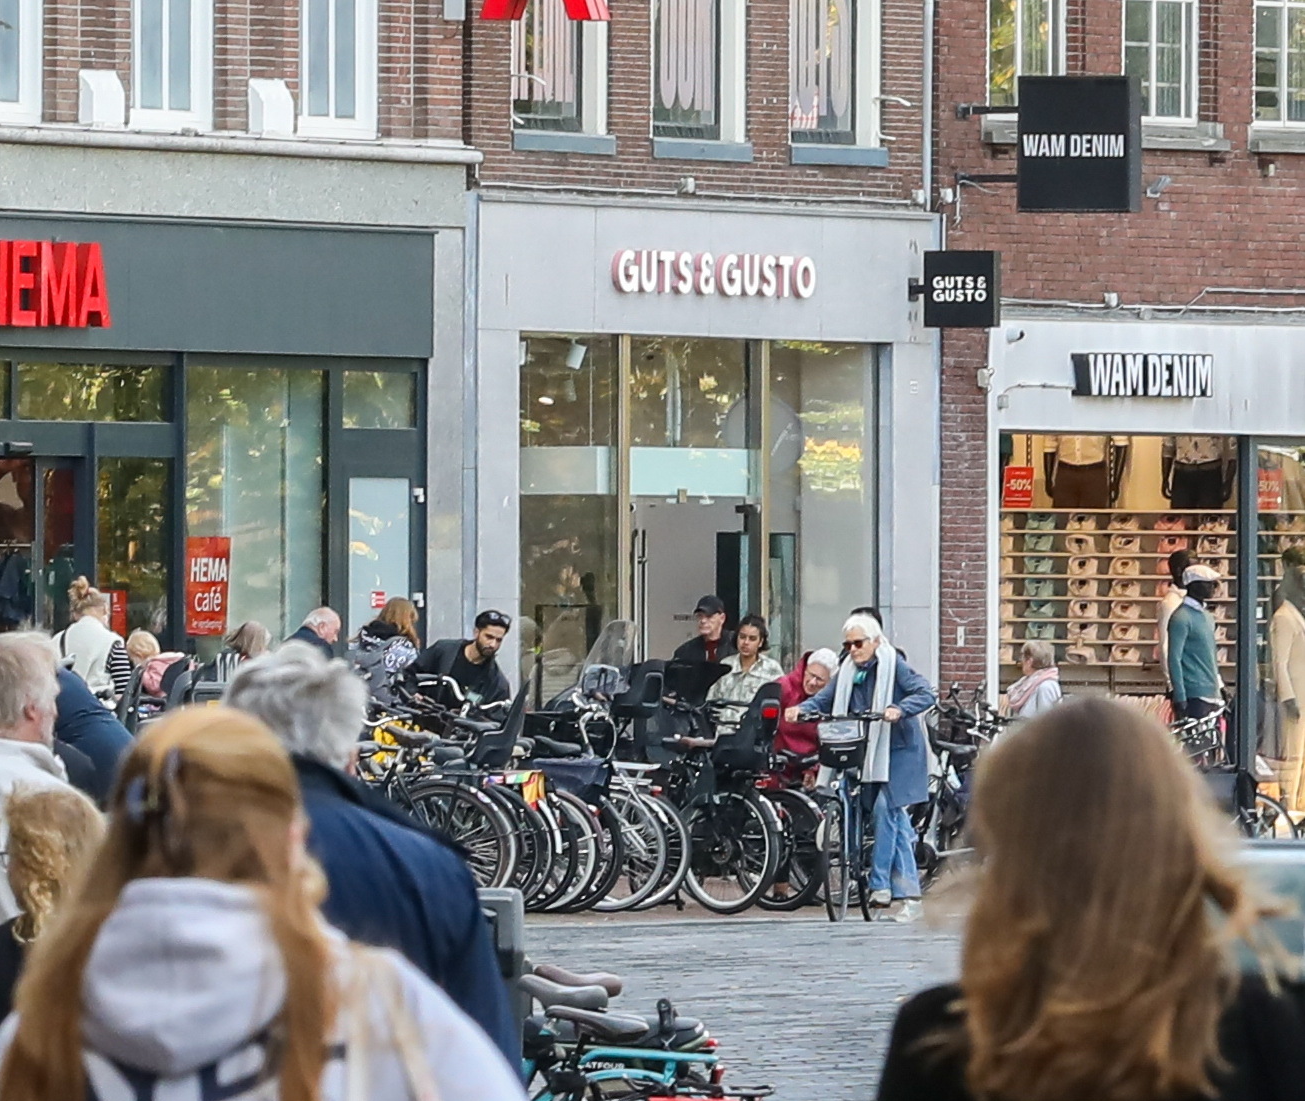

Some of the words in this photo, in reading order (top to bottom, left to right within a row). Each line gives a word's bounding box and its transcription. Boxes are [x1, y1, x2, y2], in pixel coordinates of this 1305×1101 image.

[1022, 134, 1066, 157] WAM
[1070, 134, 1125, 157] DENIM
[612, 249, 693, 295] GUTS
[716, 253, 816, 299] GUSTO
[932, 275, 975, 289] GUTS
[976, 275, 987, 289] &
[932, 289, 987, 302] GUSTO
[1088, 353, 1144, 396] WAM
[1147, 354, 1212, 397] DENIM
[1006, 479, 1032, 491] -50%
[191, 557, 228, 583] HEMA
[194, 585, 223, 612] café
